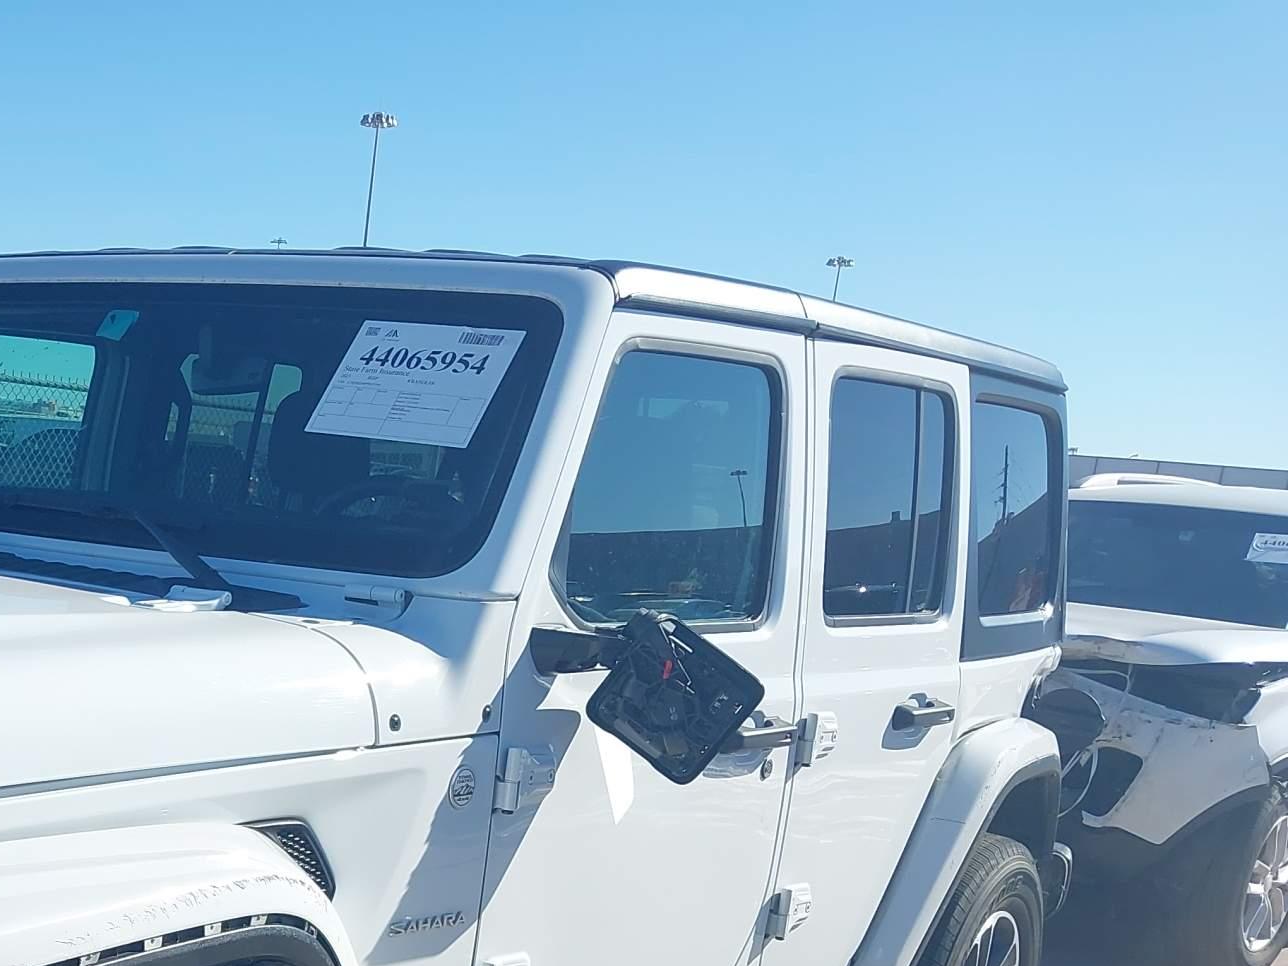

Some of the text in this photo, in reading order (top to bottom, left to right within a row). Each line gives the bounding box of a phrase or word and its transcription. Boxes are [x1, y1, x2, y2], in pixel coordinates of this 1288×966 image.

[344, 365, 360, 373] State
[360, 345, 490, 375] 44065954
[389, 911, 465, 937] SAHARA
